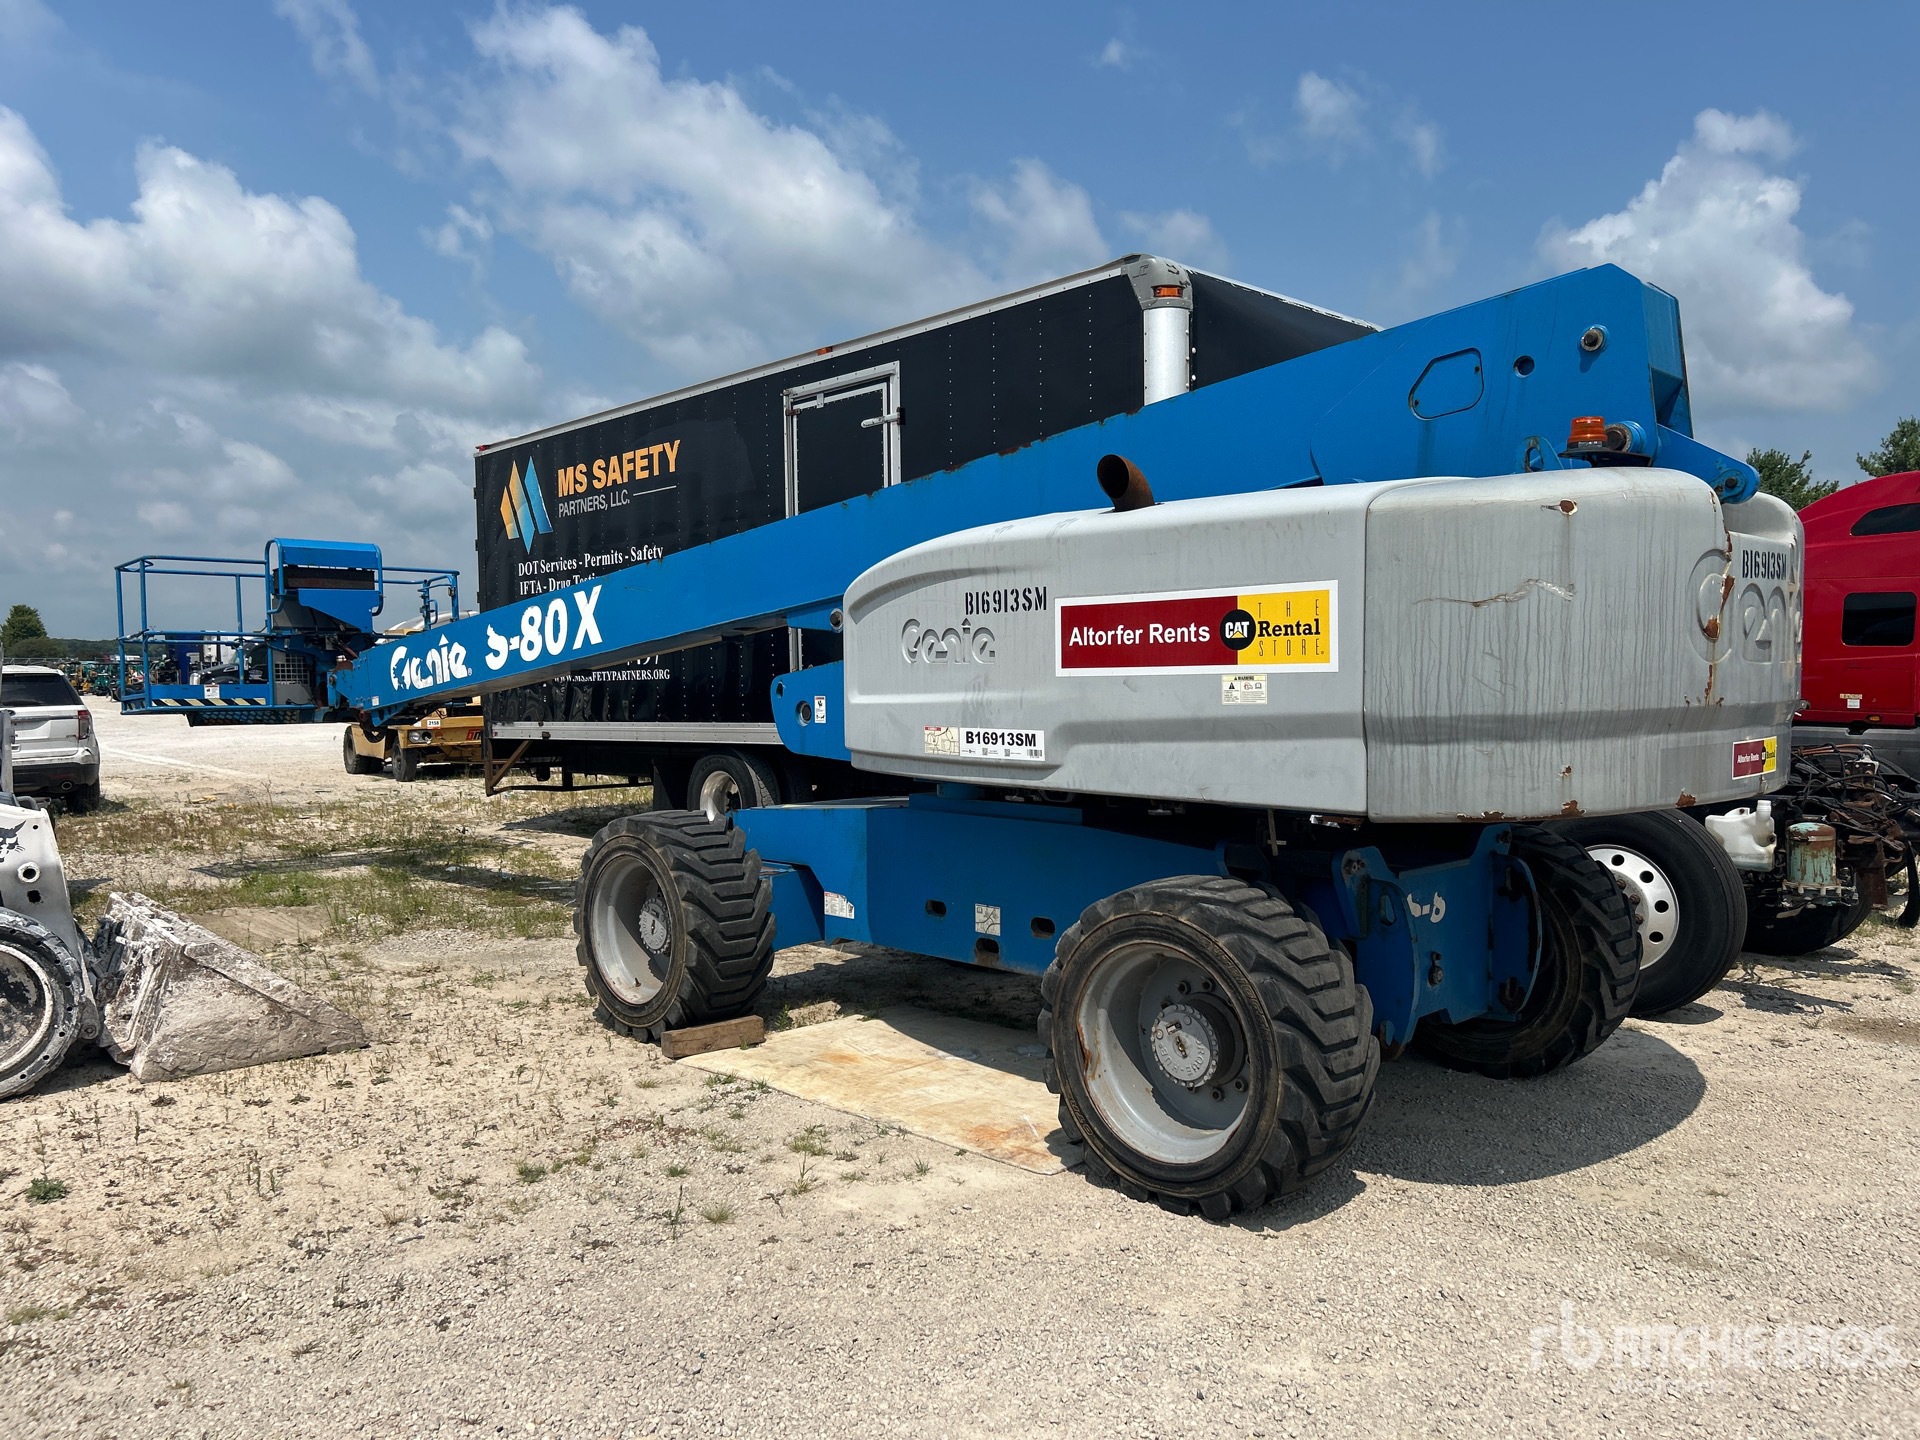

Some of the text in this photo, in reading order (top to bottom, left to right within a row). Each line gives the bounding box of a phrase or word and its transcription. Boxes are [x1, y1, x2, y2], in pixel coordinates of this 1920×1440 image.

[557, 440, 681, 498] MS SAFETY
[558, 489, 630, 518] PARTNERS, LLC.
[518, 561, 539, 576] DOT
[540, 557, 577, 573] Services
[584, 550, 623, 568] Permits
[630, 544, 664, 562] Safety
[1742, 549, 1787, 580] B16913SM
[519, 580, 542, 595] IFTA
[965, 586, 1047, 615] B16913SM
[901, 618, 996, 664] Genie
[1068, 622, 1211, 646] Altorfer Rents
[1224, 618, 1321, 639] CAT Rental
[966, 731, 1036, 747] B16913SM
